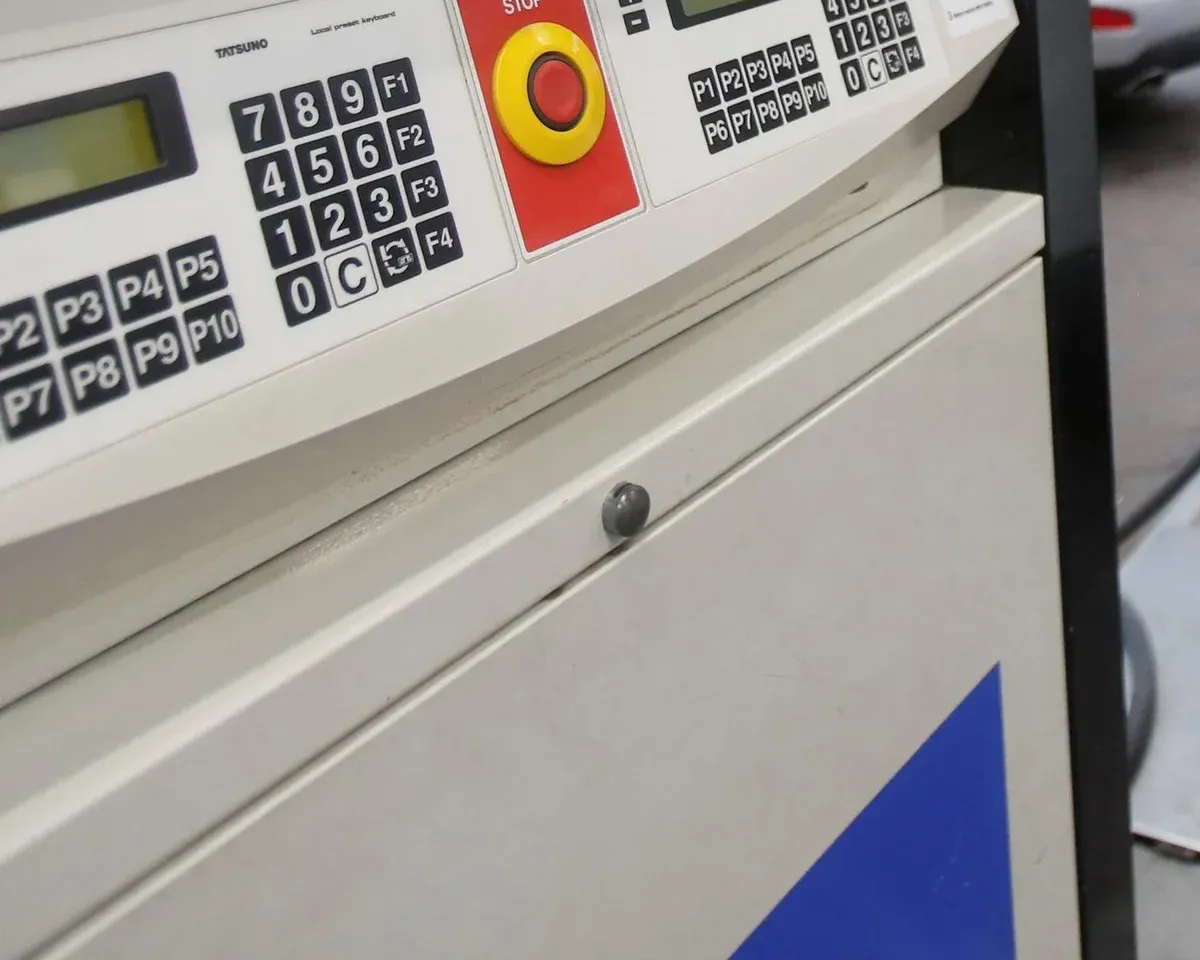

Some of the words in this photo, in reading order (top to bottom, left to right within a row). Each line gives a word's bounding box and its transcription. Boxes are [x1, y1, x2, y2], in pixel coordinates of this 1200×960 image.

[215, 38, 268, 59] TATSUNO
[310, 25, 332, 36] Local
[334, 19, 360, 31] preset
[361, 10, 396, 24] keyboard
[837, 28, 849, 53] 1
[857, 22, 871, 47] 2
[877, 15, 891, 39] 3
[896, 11, 911, 29] F3
[693, 77, 715, 103] P1
[720, 68, 744, 93] P2
[746, 59, 768, 84] P3
[770, 50, 792, 75] P4
[794, 42, 815, 66] P5
[867, 58, 882, 82] C
[906, 45, 920, 63] F4
[242, 103, 266, 142] 7
[294, 91, 320, 128] 8
[340, 79, 365, 115] 9
[382, 72, 409, 99] F1
[705, 119, 729, 146] P6
[731, 109, 751, 135] P7
[757, 100, 780, 125] P8
[782, 90, 803, 115] P9
[804, 80, 828, 106] P10
[262, 160, 287, 198] 4
[309, 146, 335, 185] 5
[356, 133, 380, 169] 6
[396, 124, 426, 151] F2
[276, 218, 298, 257] 1
[323, 202, 350, 241] 2
[369, 187, 395, 223] 3
[410, 175, 439, 203] F3
[53, 289, 104, 335] P3
[116, 268, 164, 312] P4
[174, 248, 220, 290] P5
[290, 275, 317, 316] 0
[337, 256, 367, 295] C
[424, 227, 453, 256] F4
[2, 376, 53, 428] P7
[69, 354, 122, 401] P8
[132, 331, 181, 376] P9
[187, 308, 239, 353] P10
